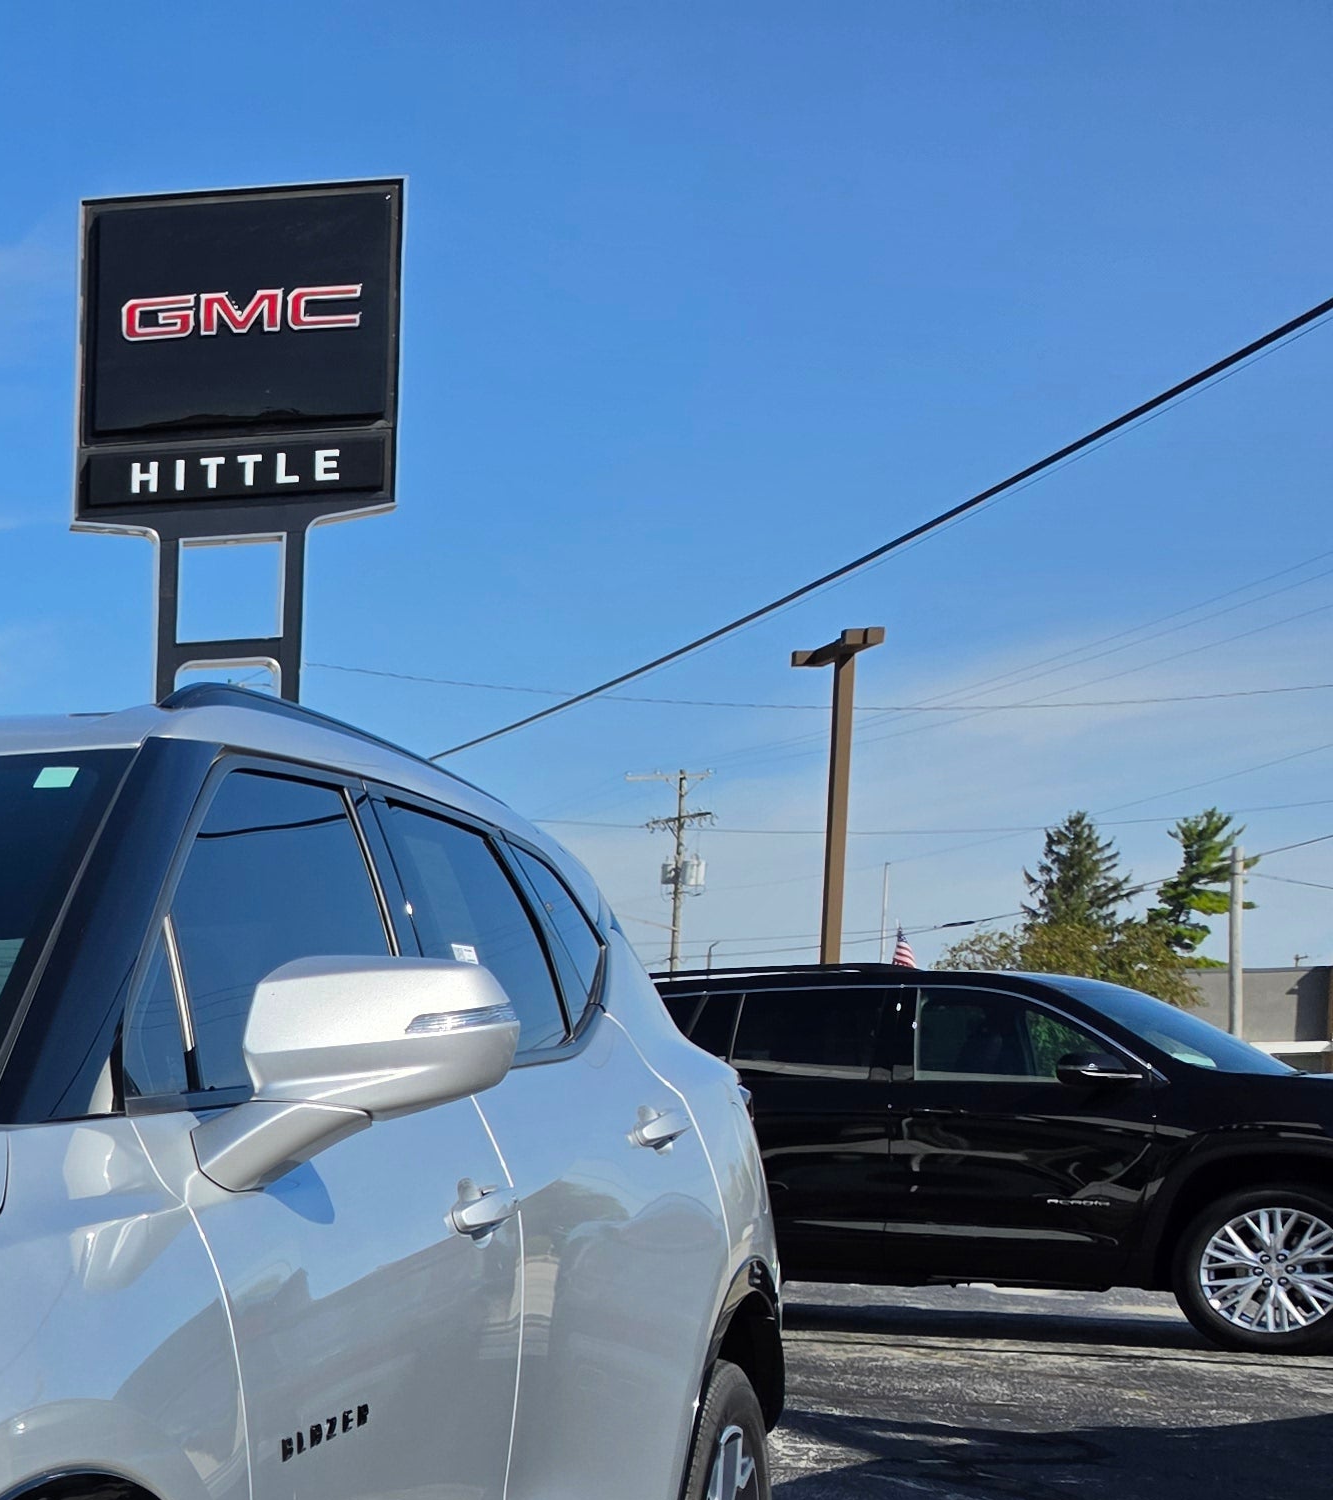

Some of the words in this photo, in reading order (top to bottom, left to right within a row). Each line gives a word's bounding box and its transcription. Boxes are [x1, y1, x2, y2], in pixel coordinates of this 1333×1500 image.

[121, 282, 363, 342] GMC
[130, 448, 341, 494] HITTLE
[280, 1403, 370, 1463] BLAZER
